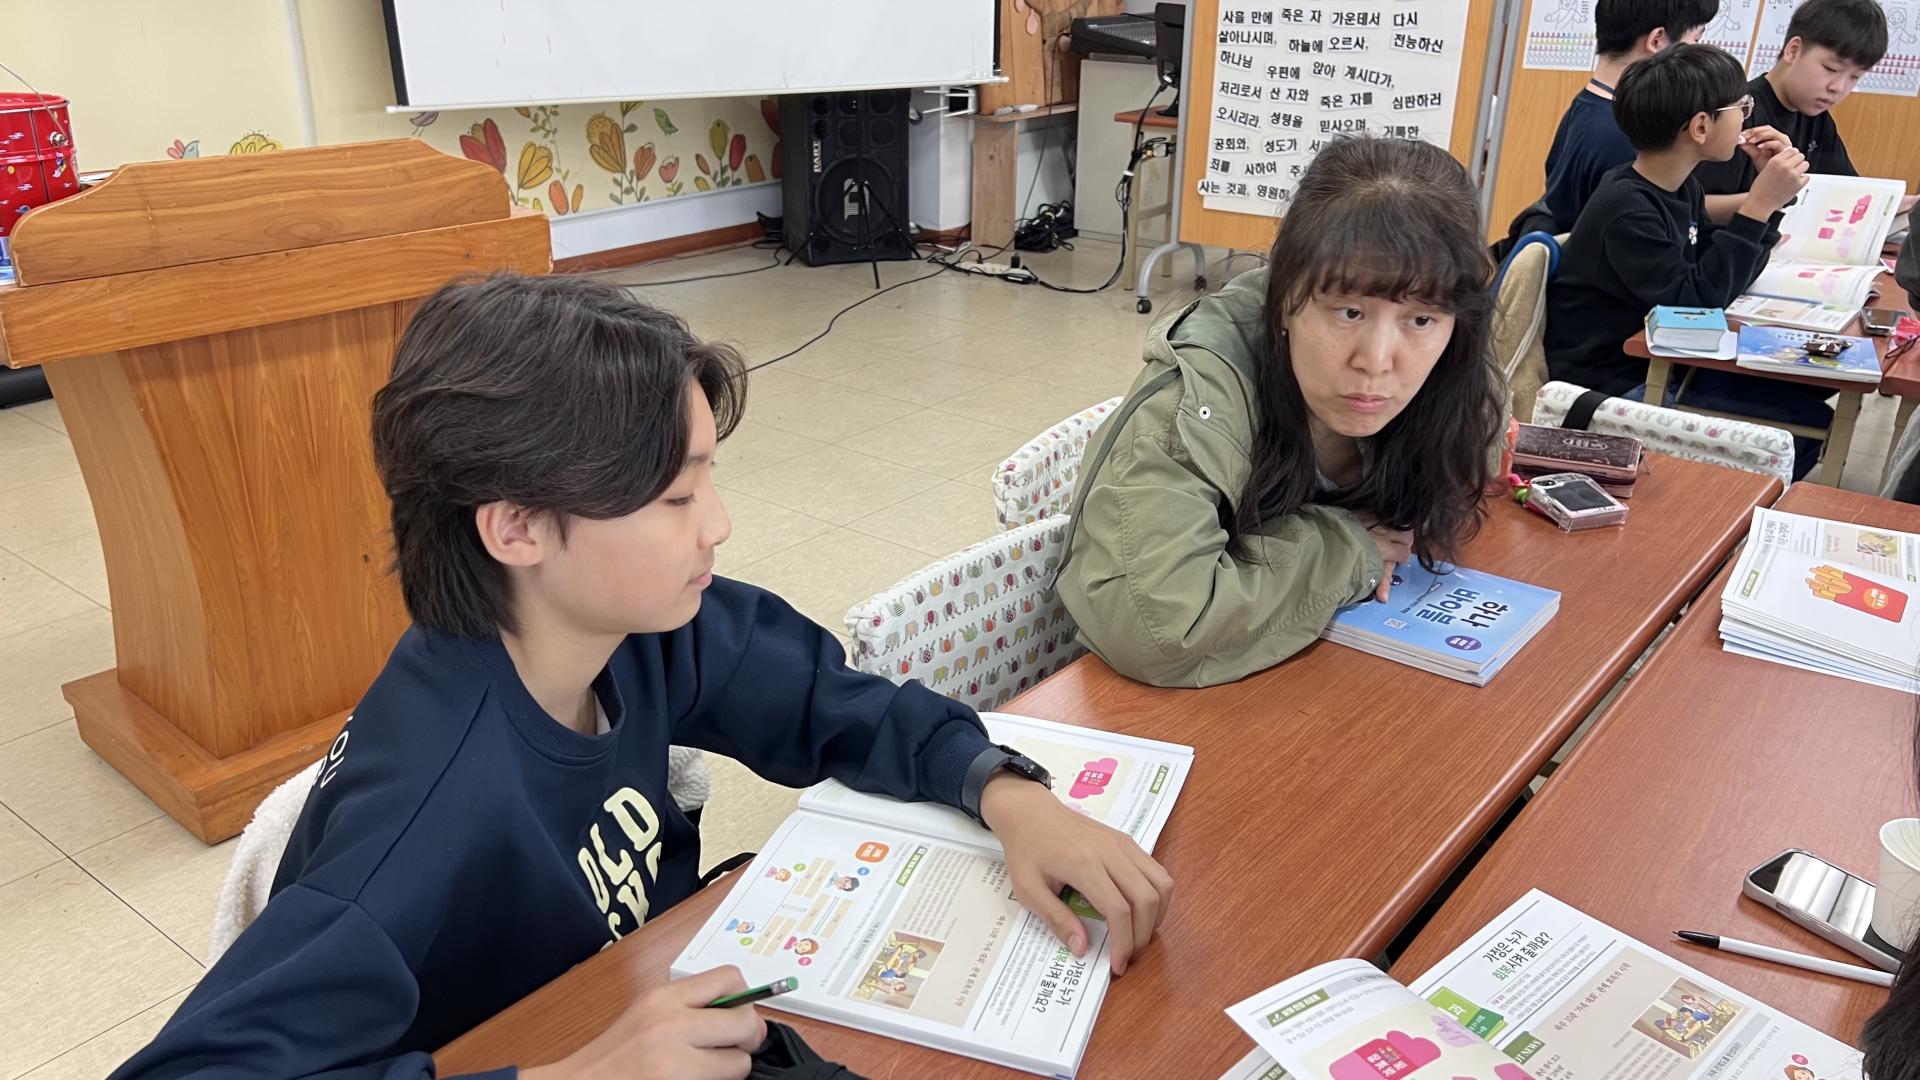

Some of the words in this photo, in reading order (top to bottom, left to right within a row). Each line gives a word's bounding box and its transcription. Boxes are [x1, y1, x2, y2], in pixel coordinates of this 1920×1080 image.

[1223, 11, 1244, 24] 사흘
[1252, 11, 1273, 24] 만에
[1281, 9, 1303, 22] 죽은
[1310, 10, 1322, 23] 자
[1393, 12, 1417, 26] 다시
[1289, 39, 1323, 52] 하늘에
[1394, 34, 1443, 53] 전능하신
[1220, 51, 1253, 69] 하나님
[1267, 66, 1300, 80] 우편에
[1313, 62, 1336, 78] 앉아
[1219, 82, 1262, 99] 저리로서
[1270, 87, 1280, 100] 산
[1286, 88, 1309, 101] 자와
[1320, 95, 1343, 108] 죽은
[1350, 92, 1373, 106] 자를
[1392, 93, 1441, 109] 심판하러
[1270, 112, 1303, 129] 성령을
[1383, 125, 1419, 139] 거룩한
[1264, 138, 1297, 153] 성도가
[1210, 158, 1230, 173] 죄를
[1244, 161, 1277, 175] 사하여
[1199, 181, 1220, 193] 사는
[1415, 588, 1481, 625] 바이블
[1460, 601, 1509, 628] 하나
[1482, 942, 1514, 962] 가정은
[1505, 930, 1528, 945] 누가
[1492, 953, 1529, 981] 회복시켜
[1520, 931, 1553, 958] 줄까요?
[1063, 960, 1086, 986] 가정은
[1032, 980, 1057, 1013] 줄까요?
[1056, 987, 1075, 1005] 누가
[1520, 1040, 1541, 1057] NEWS
